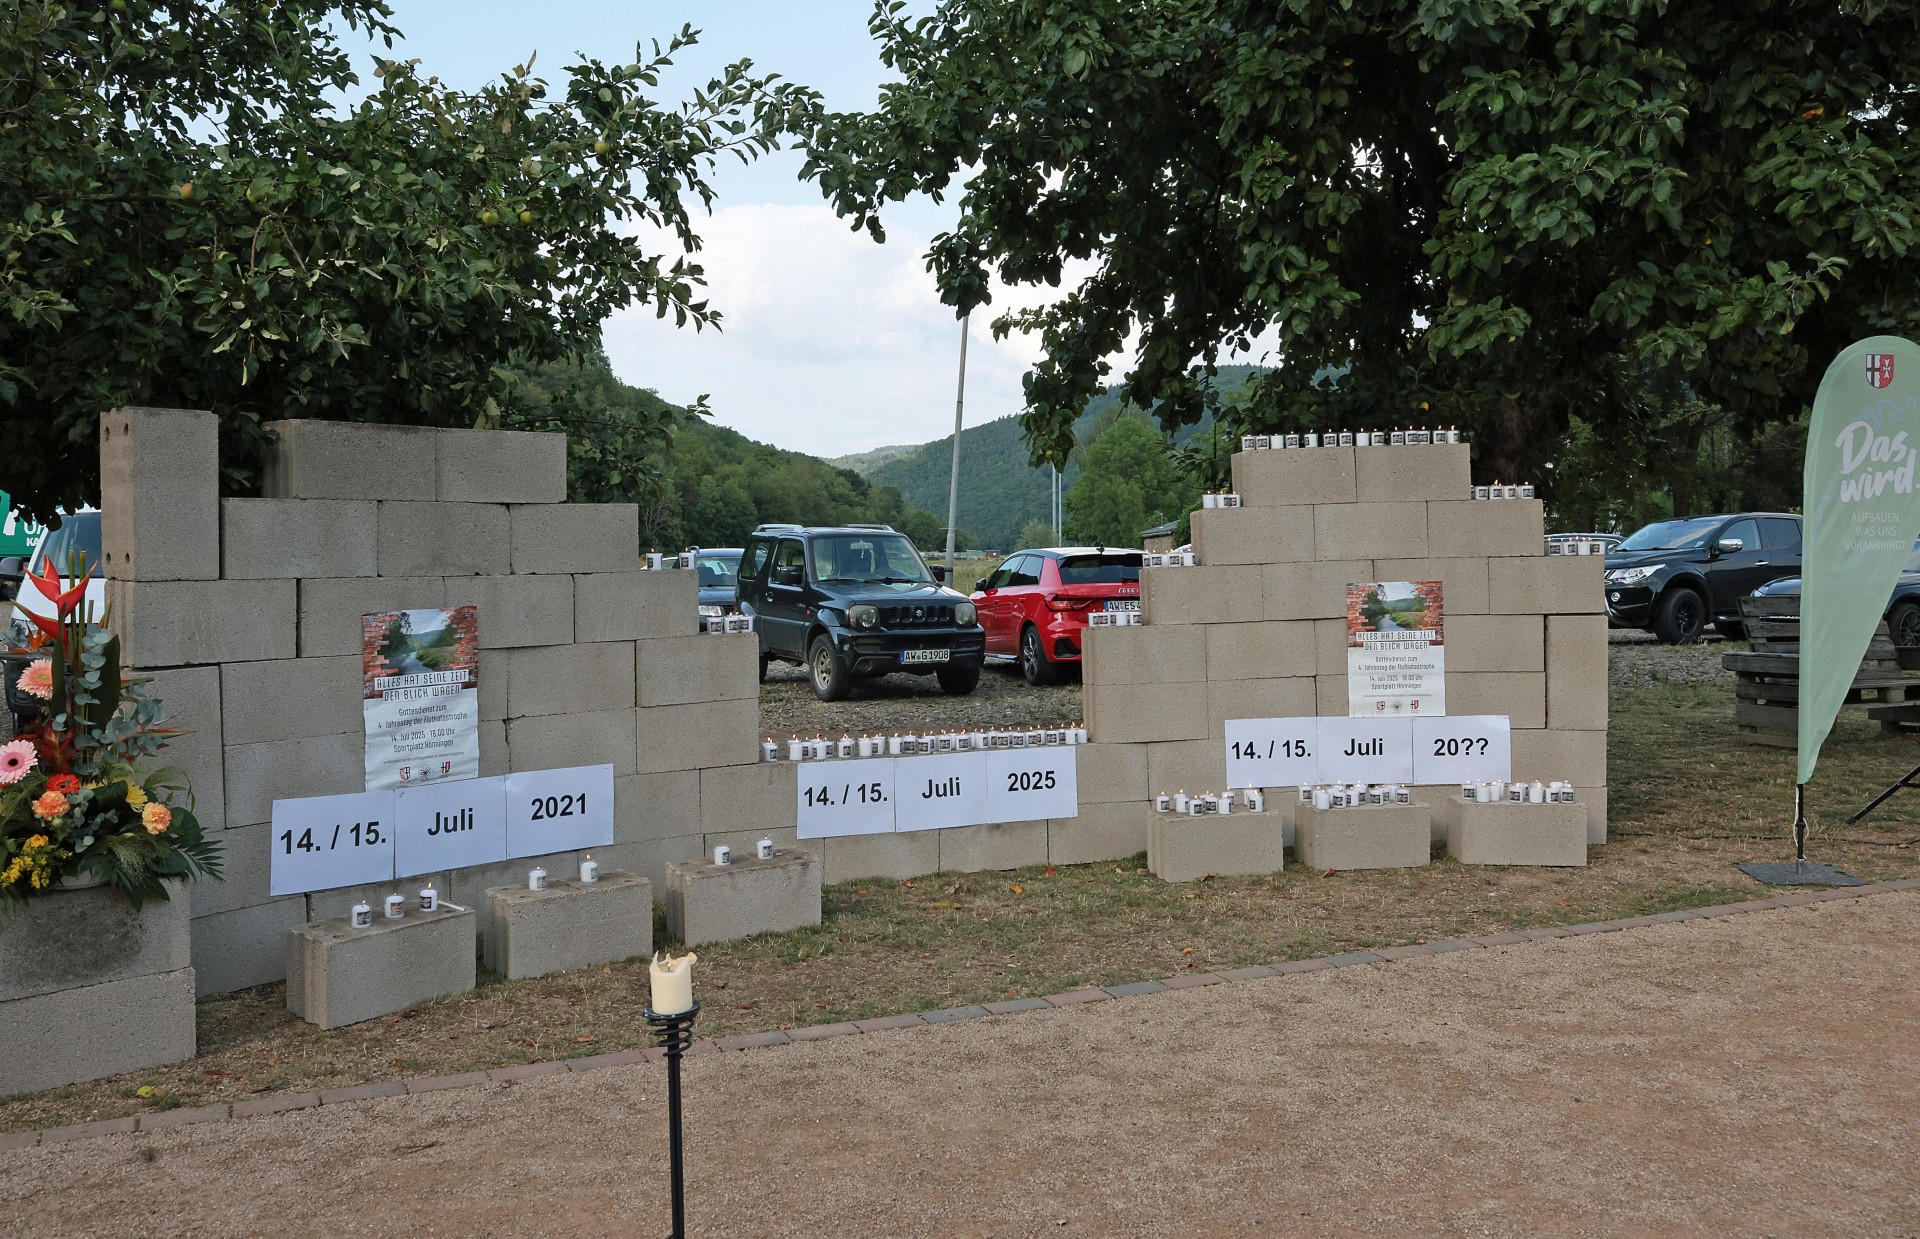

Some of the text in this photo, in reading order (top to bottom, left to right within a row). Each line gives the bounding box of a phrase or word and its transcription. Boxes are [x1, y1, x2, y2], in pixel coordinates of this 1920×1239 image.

[1835, 421, 1909, 474] Das
[1855, 526, 1897, 536] WAS UNS
[1844, 540, 1907, 551] VORANBRINGT
[1357, 632, 1378, 641] ALLES
[1397, 631, 1417, 640] SEINE
[1403, 641, 1428, 650] WAGEN
[377, 671, 467, 688] ALLES HAT SEINE ZEIT
[385, 685, 460, 702] DEN BLICK WAGEN
[399, 707, 435, 716] Gottesdienst
[386, 719, 412, 728] Jahrestag
[424, 713, 468, 724] Flutkatastrophe
[412, 731, 426, 740] 2025
[394, 742, 424, 754] Sportplatz
[1343, 738, 1384, 757] Juli
[1433, 737, 1489, 757] 20??
[922, 777, 961, 800] Juli
[1007, 770, 1056, 792] 2025
[427, 808, 474, 836] Juli
[531, 793, 587, 821] 2021
